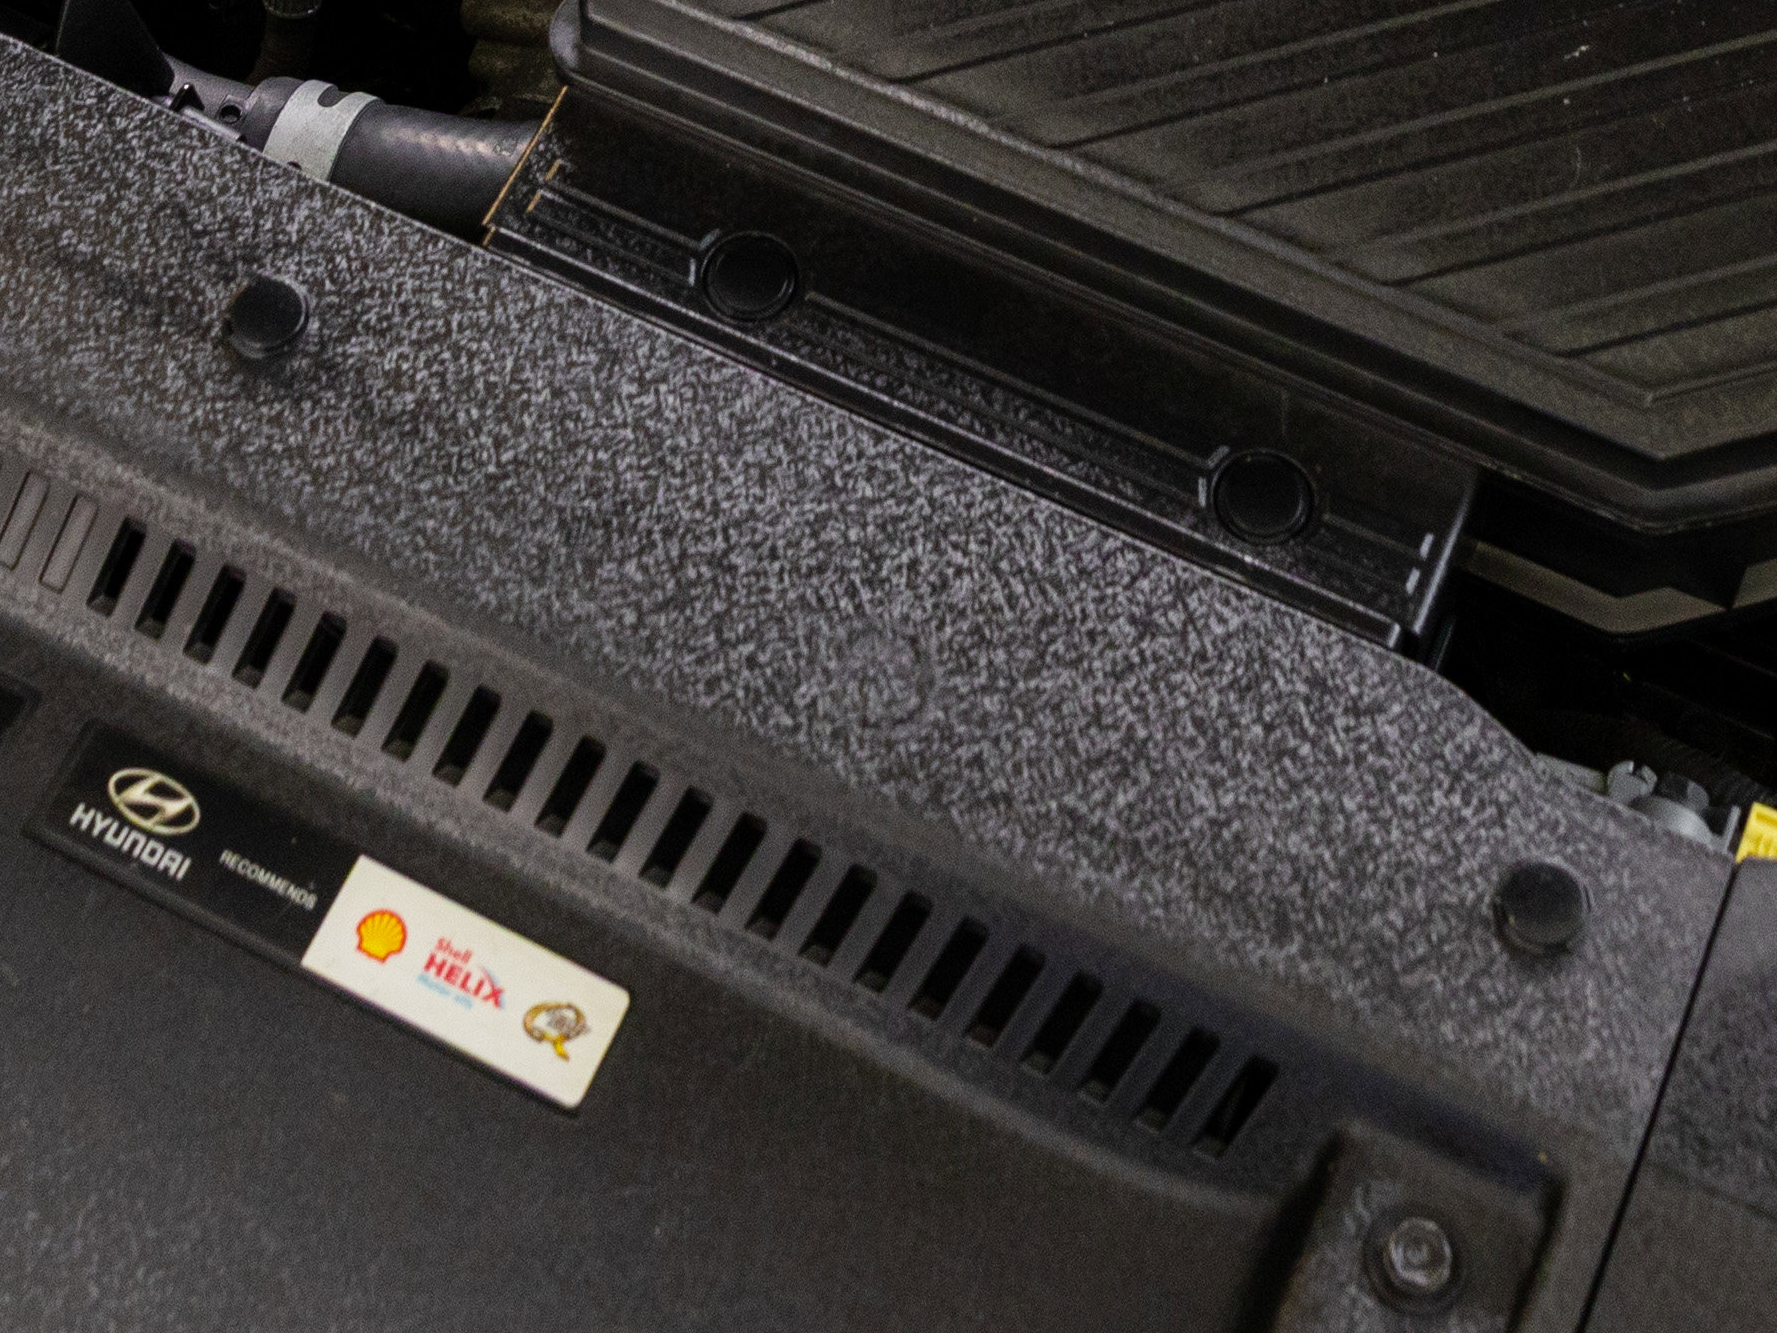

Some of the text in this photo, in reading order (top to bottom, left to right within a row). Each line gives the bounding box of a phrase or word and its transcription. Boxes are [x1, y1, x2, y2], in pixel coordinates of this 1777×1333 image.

[67, 800, 320, 913] HYUNDAI RECOMMENDS
[434, 935, 474, 965] Shell
[422, 952, 505, 1010] HELIX
